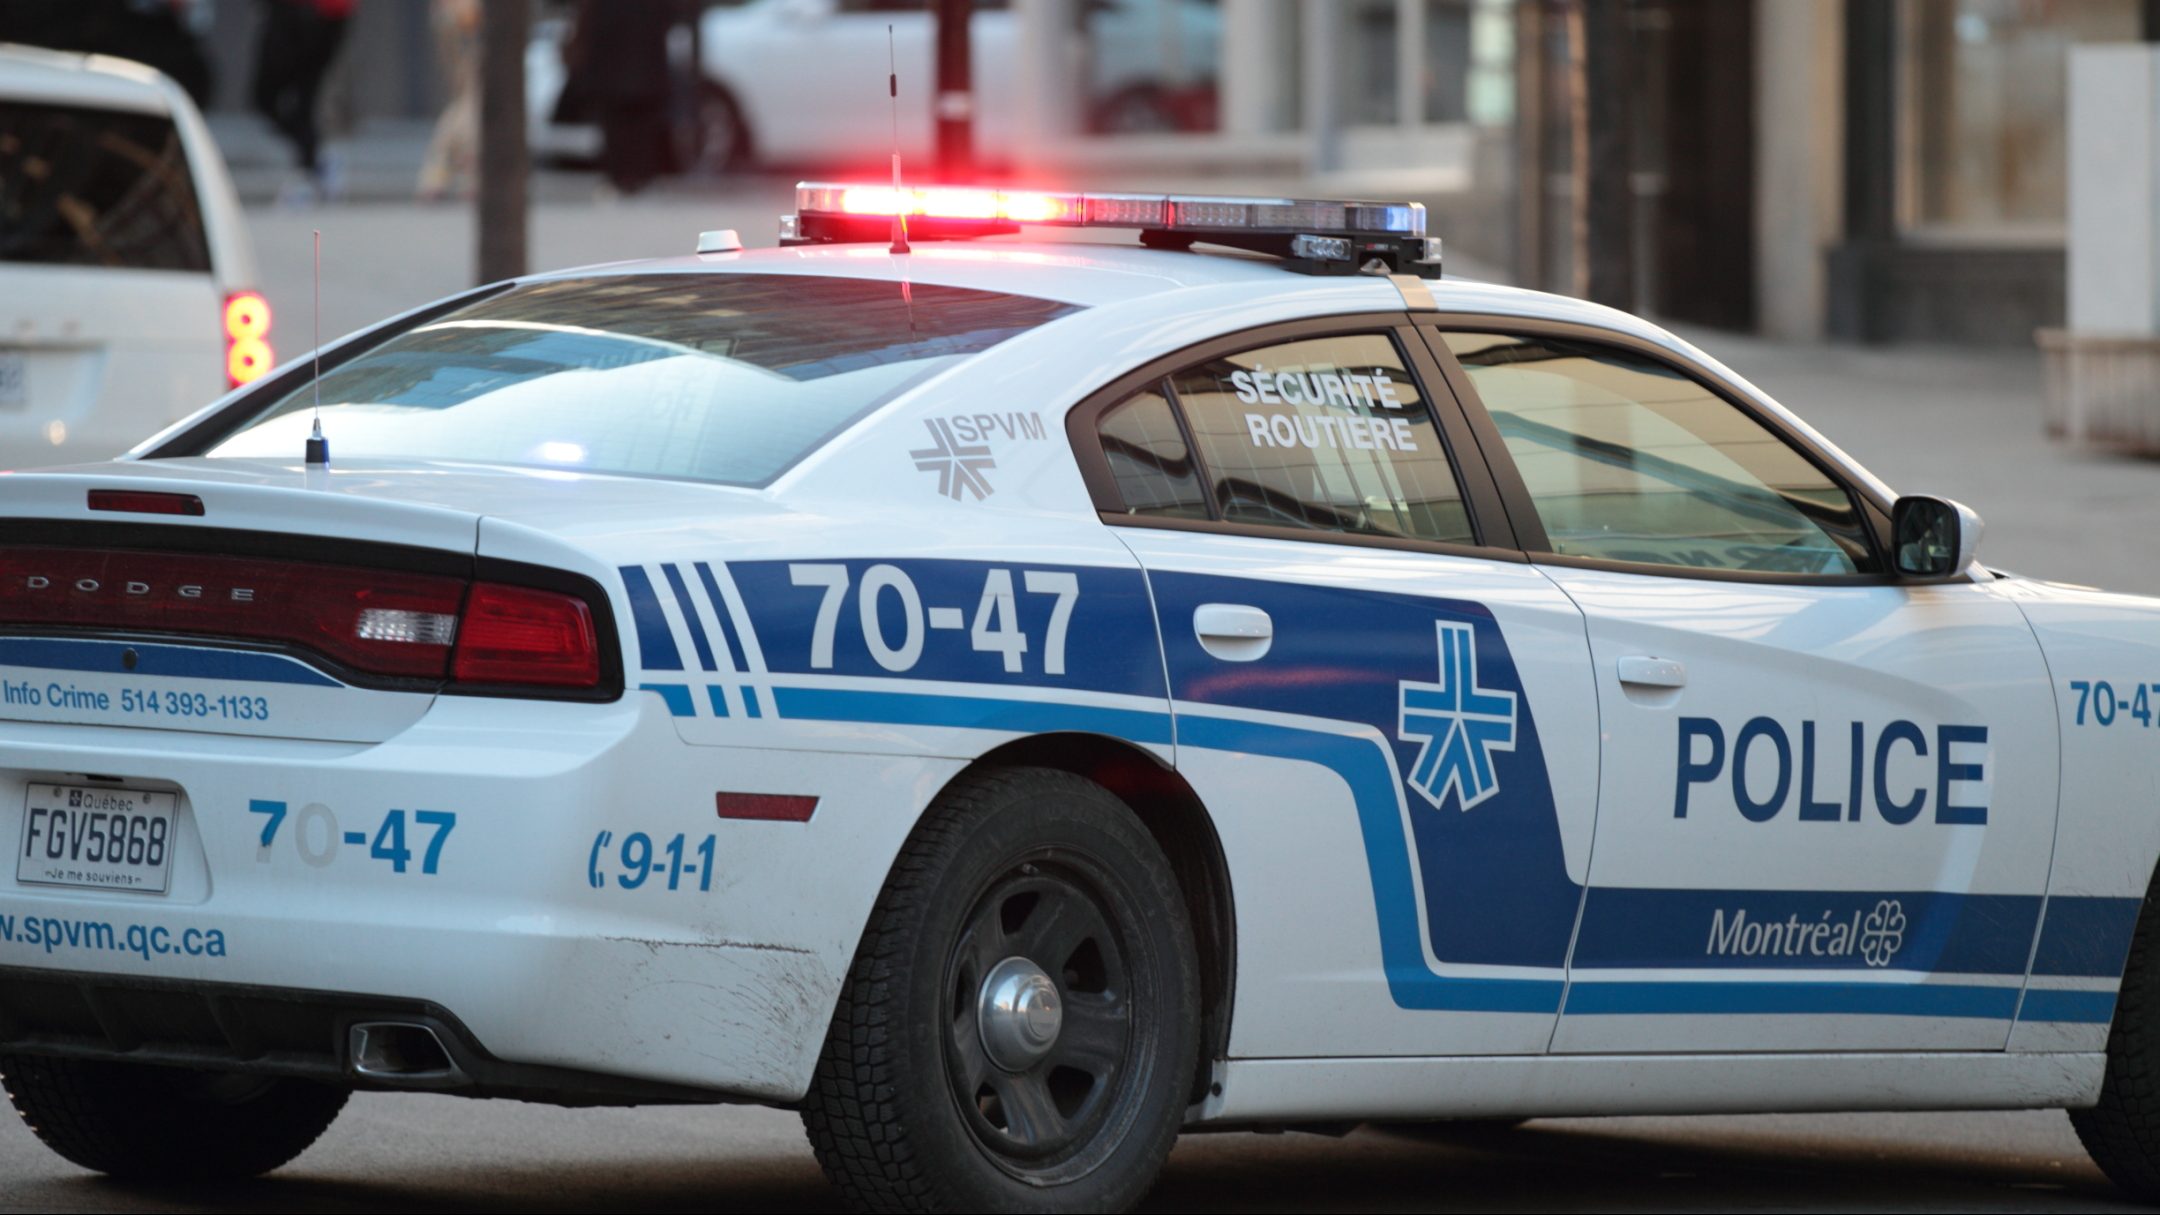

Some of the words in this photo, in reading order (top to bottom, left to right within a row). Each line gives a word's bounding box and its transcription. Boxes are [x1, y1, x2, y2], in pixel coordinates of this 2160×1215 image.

[1231, 363, 1402, 409] SÉCURITÉ
[951, 411, 1047, 443] SPVM
[1244, 407, 1418, 452] ROUTIÈRE
[27, 576, 254, 601] DODGE
[788, 563, 1079, 675] 70-47
[3, 680, 41, 706] Info
[46, 683, 110, 710] Crime
[121, 688, 159, 713] 514
[165, 691, 269, 720] 393-1133
[1673, 716, 1988, 826] POLICE
[83, 793, 134, 812] Québec
[26, 807, 167, 866] FGV5868
[249, 798, 456, 874] 70-47
[67, 869, 83, 881] me
[86, 871, 133, 885] souviens
[618, 832, 716, 892] 9-1-1
[1706, 909, 1861, 956] Montréal
